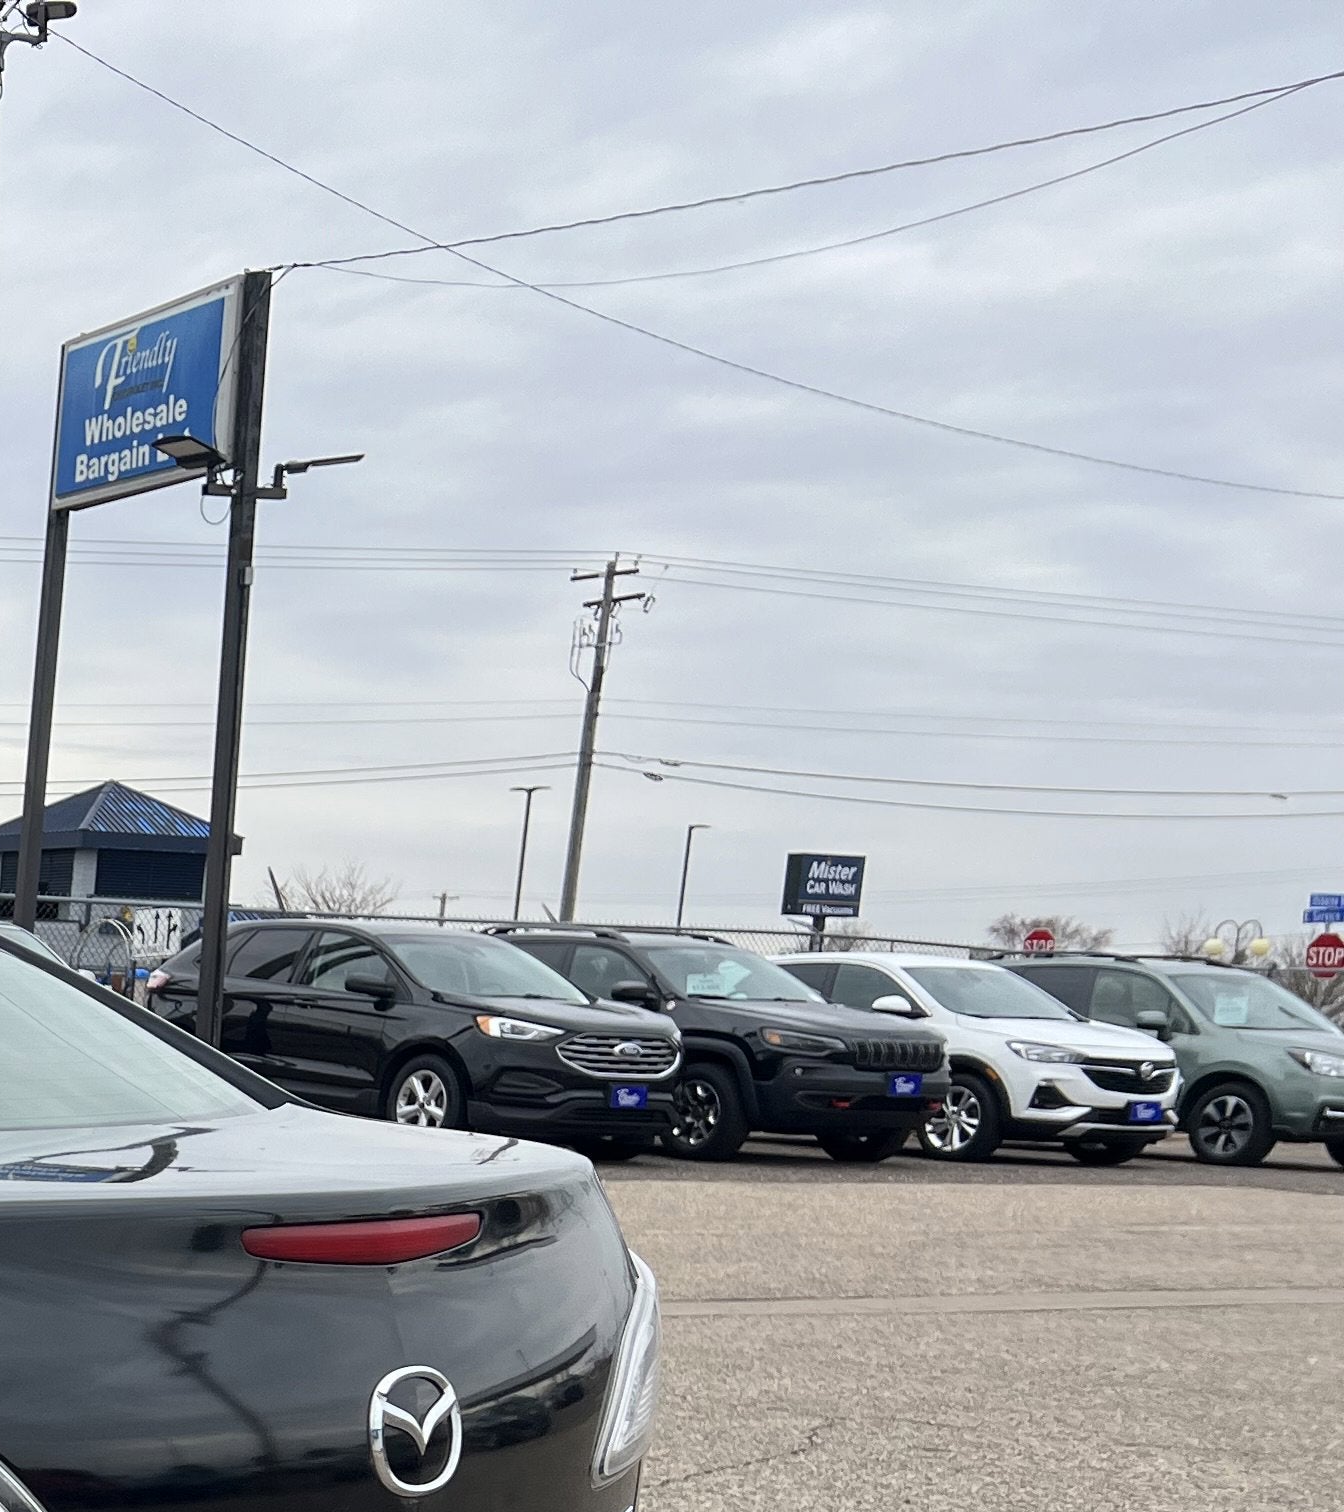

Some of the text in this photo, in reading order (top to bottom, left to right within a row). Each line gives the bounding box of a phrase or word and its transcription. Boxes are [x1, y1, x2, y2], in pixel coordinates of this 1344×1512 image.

[95, 326, 178, 410] Friendly
[85, 394, 188, 447] Wholesale
[75, 440, 150, 483] Bargain
[808, 860, 858, 881] Mister
[806, 879, 826, 895] CAR
[1025, 939, 1054, 951] STOP
[1307, 946, 1344, 967] STOP
